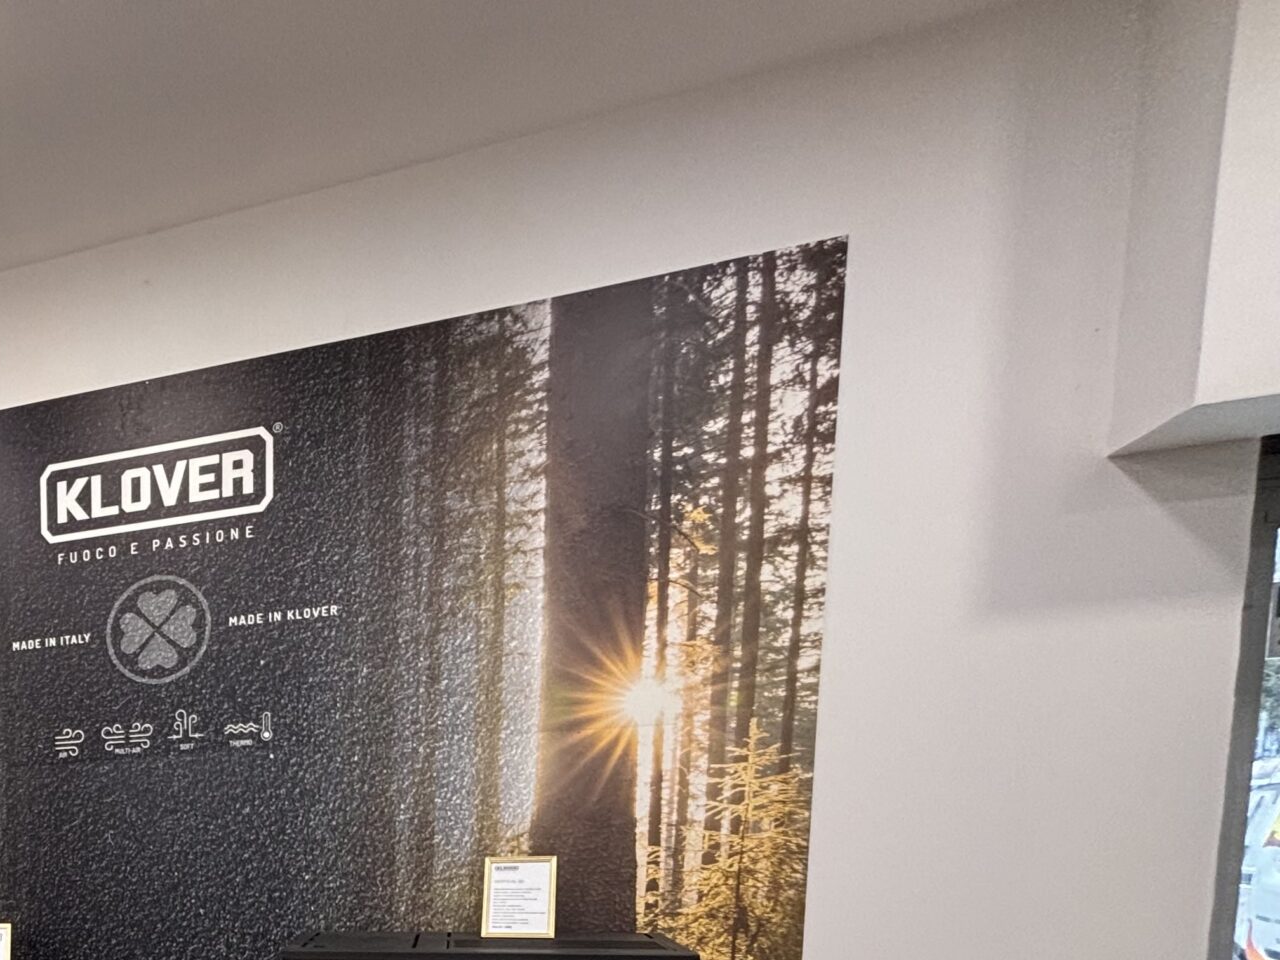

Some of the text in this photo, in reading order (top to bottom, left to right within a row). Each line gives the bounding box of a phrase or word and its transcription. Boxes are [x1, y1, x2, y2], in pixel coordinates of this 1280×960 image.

[56, 449, 255, 524] KLOVER
[57, 525, 255, 565] FUOCO E PASSIONE
[228, 604, 338, 627] MADE IN KLOVER
[12, 632, 91, 652] MADE IN ITALY
